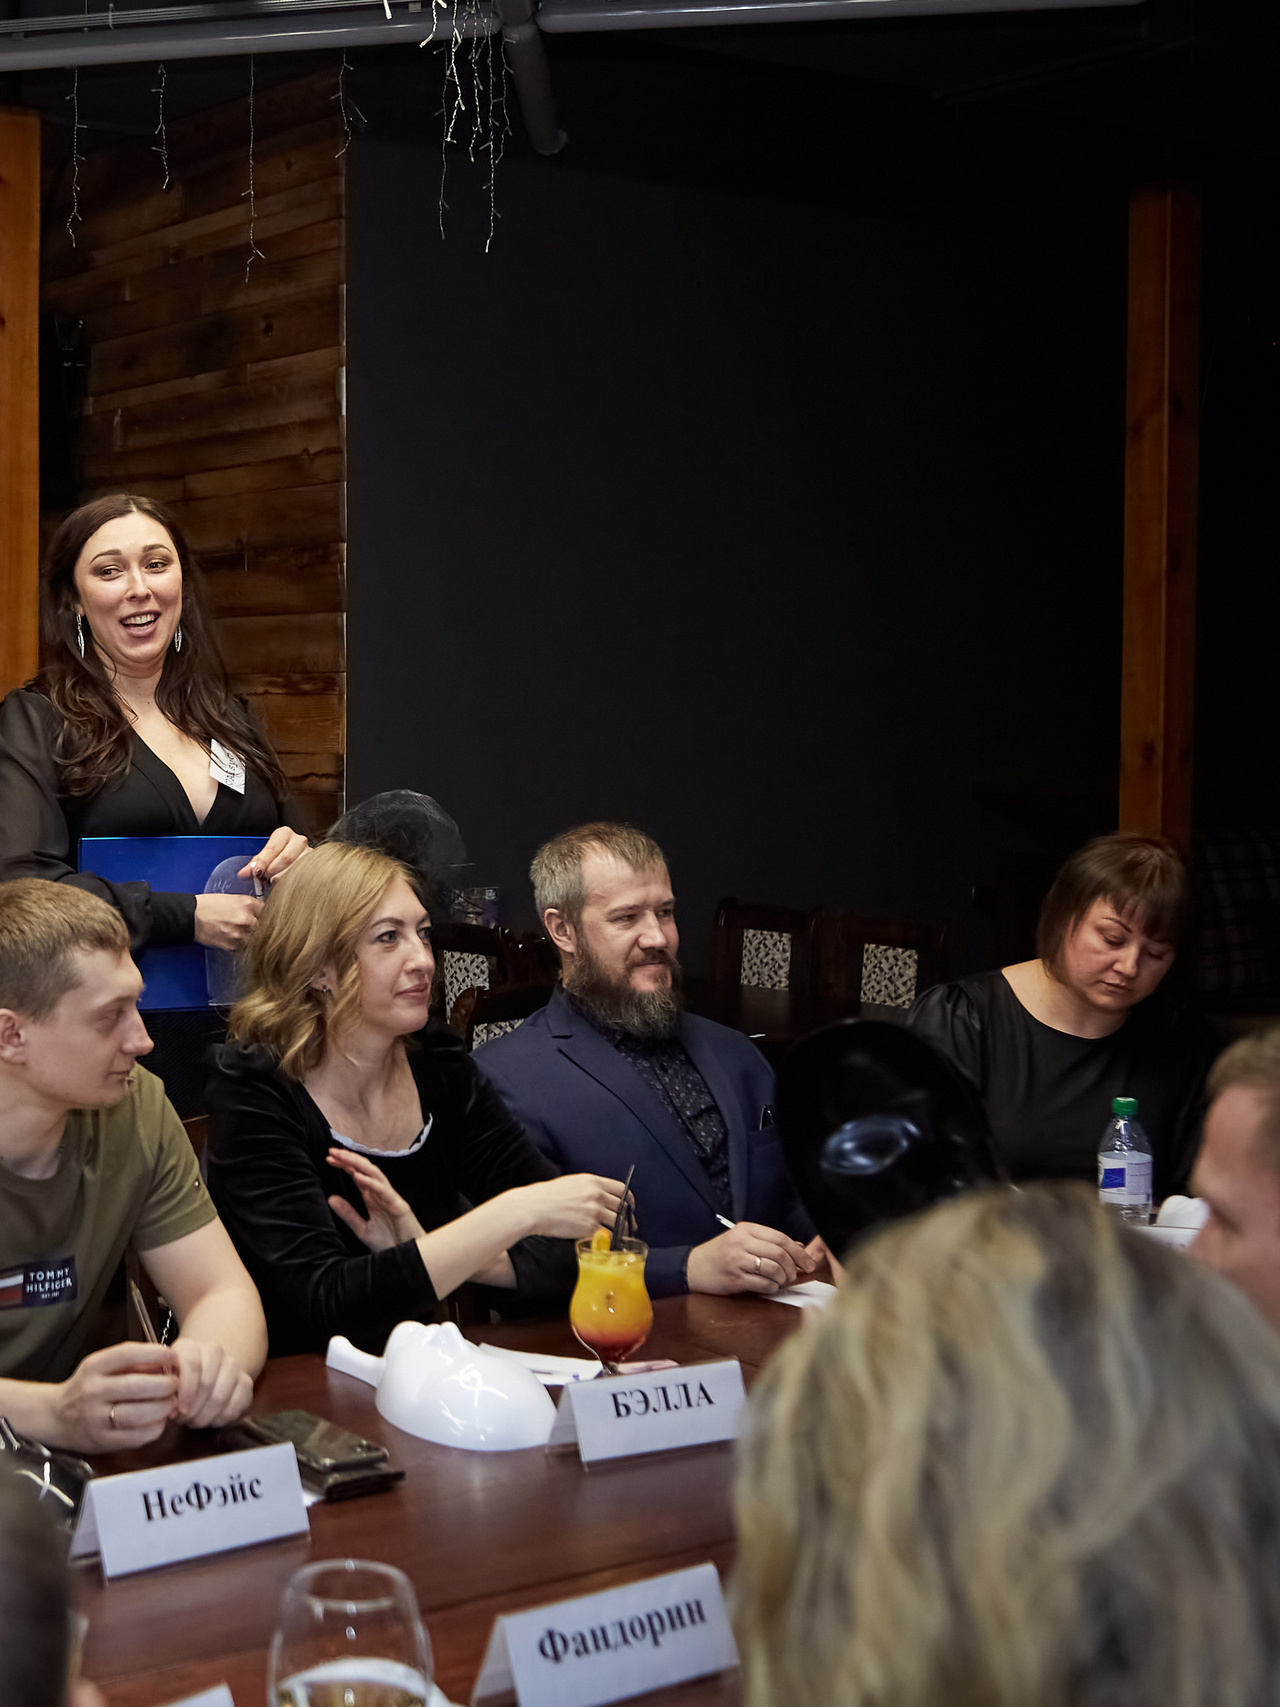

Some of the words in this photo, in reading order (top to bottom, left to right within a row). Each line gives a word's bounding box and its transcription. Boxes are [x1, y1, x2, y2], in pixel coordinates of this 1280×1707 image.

[26, 1277, 72, 1293] HILFIGER
[30, 1266, 70, 1281] TOMMY
[611, 1381, 715, 1418] БЭЛЛА
[141, 1473, 264, 1522] НеФэйс
[538, 1599, 707, 1664] Фандорин
